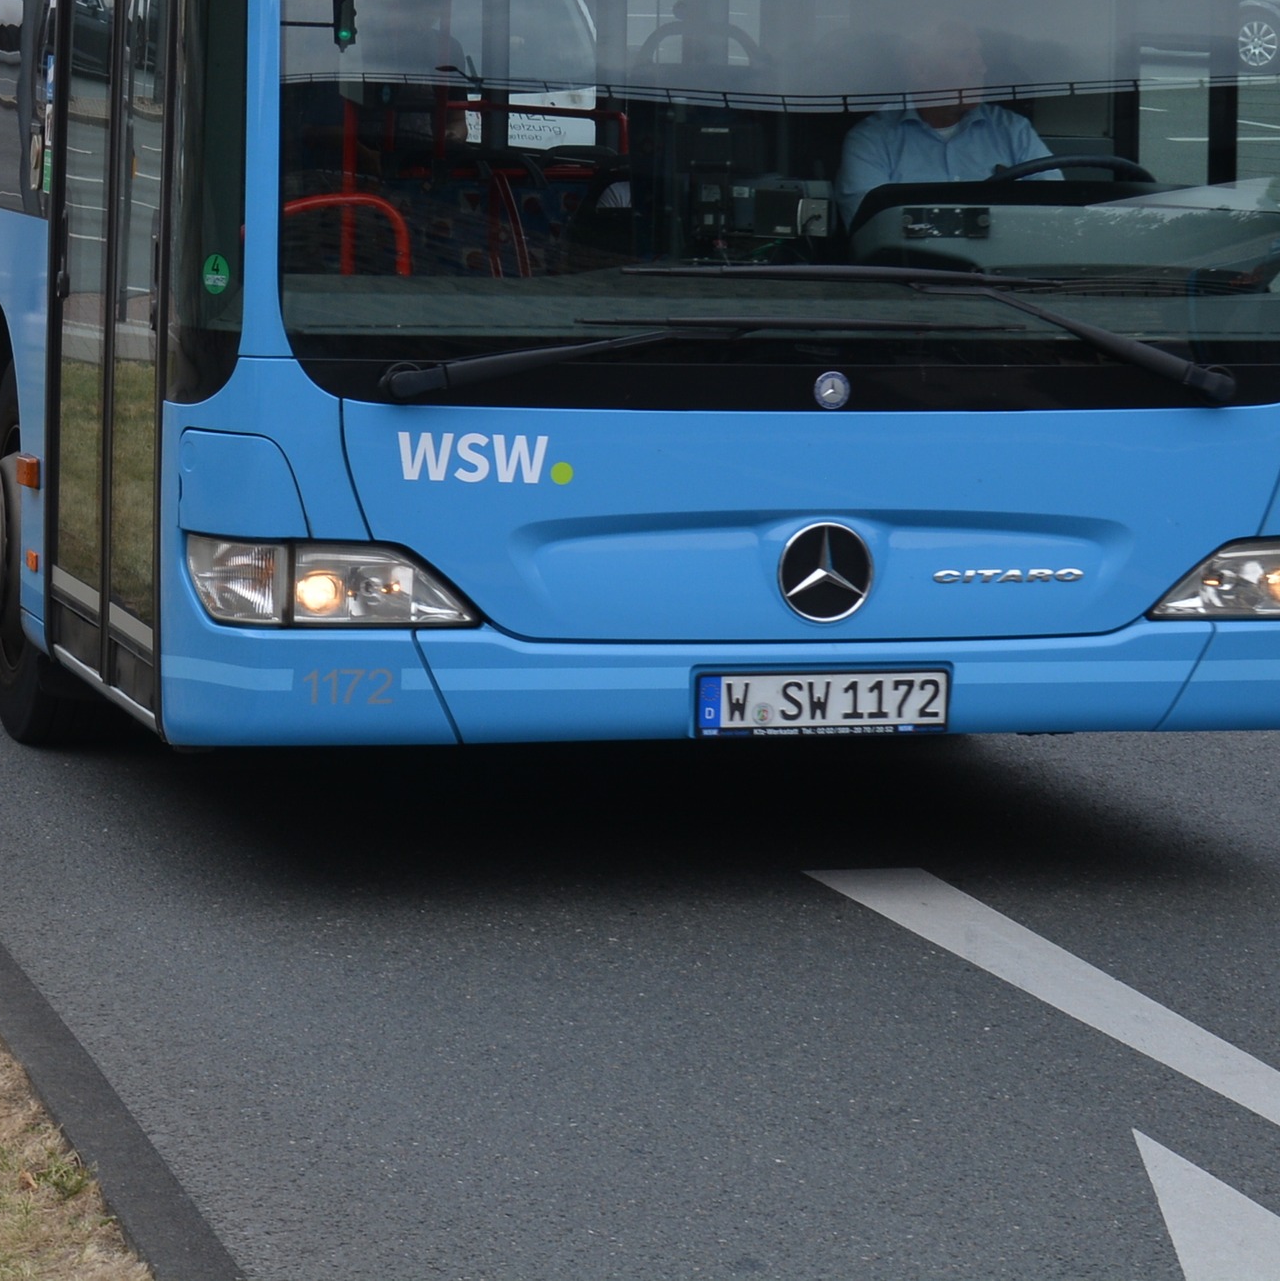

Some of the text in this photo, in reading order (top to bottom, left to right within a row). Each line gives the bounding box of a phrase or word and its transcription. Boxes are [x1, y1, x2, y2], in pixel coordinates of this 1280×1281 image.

[211, 255, 220, 274] 4
[932, 568, 1084, 584] CITARO
[303, 668, 395, 705] 1172
[725, 682, 750, 722] W
